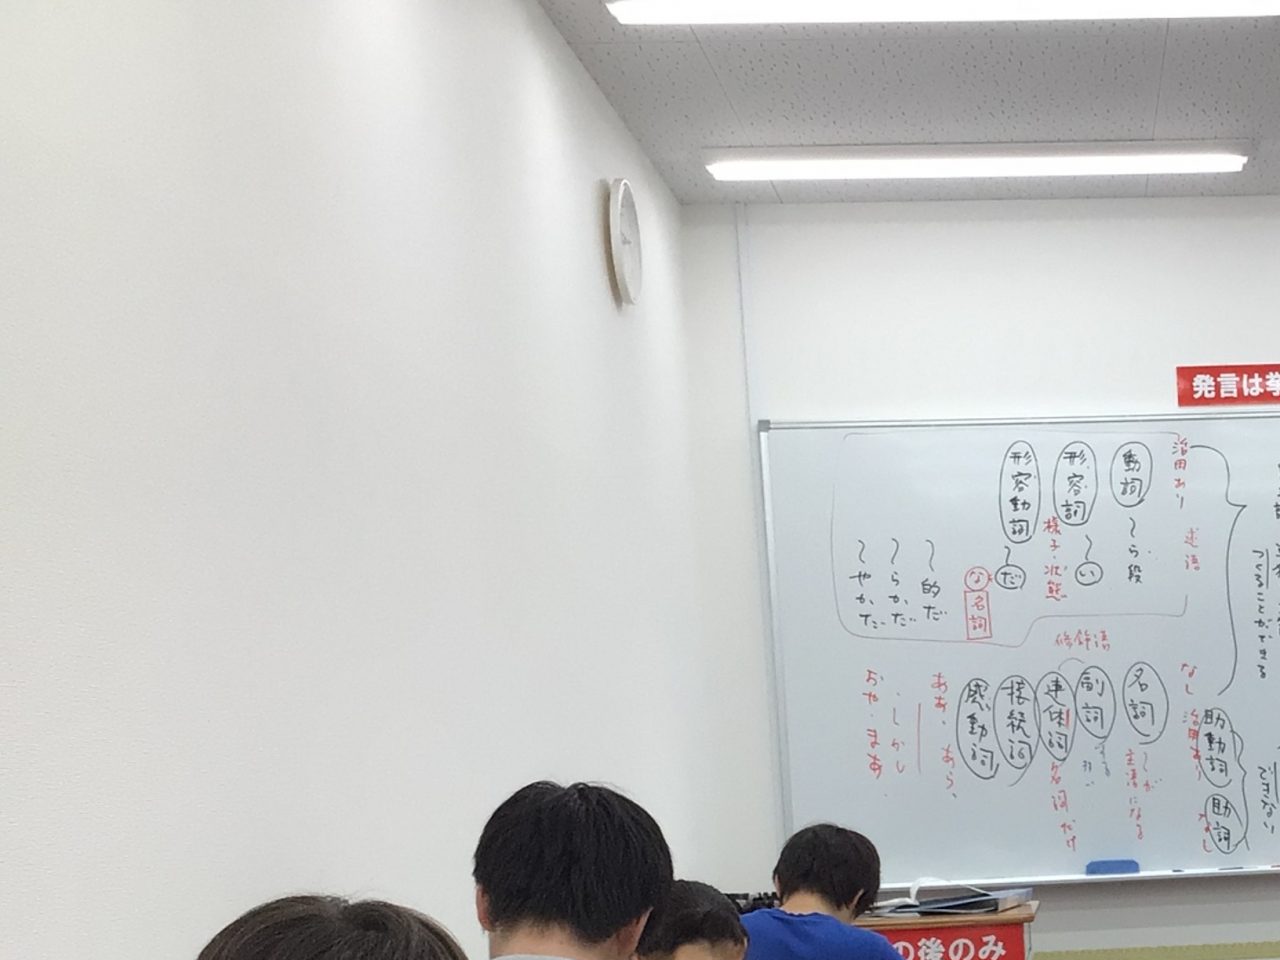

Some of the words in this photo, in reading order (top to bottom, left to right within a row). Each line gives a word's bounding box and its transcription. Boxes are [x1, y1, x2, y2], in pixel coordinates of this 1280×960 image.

[1009, 450, 1032, 537] 形容動詞
[1061, 450, 1086, 522] 形容詞
[1120, 449, 1143, 498] 動詞
[971, 595, 988, 633] 名詞
[1080, 672, 1105, 730] 副詞
[1124, 667, 1156, 726] 名詞
[1203, 708, 1228, 778] 助動詞
[1212, 796, 1232, 850] 助詞
